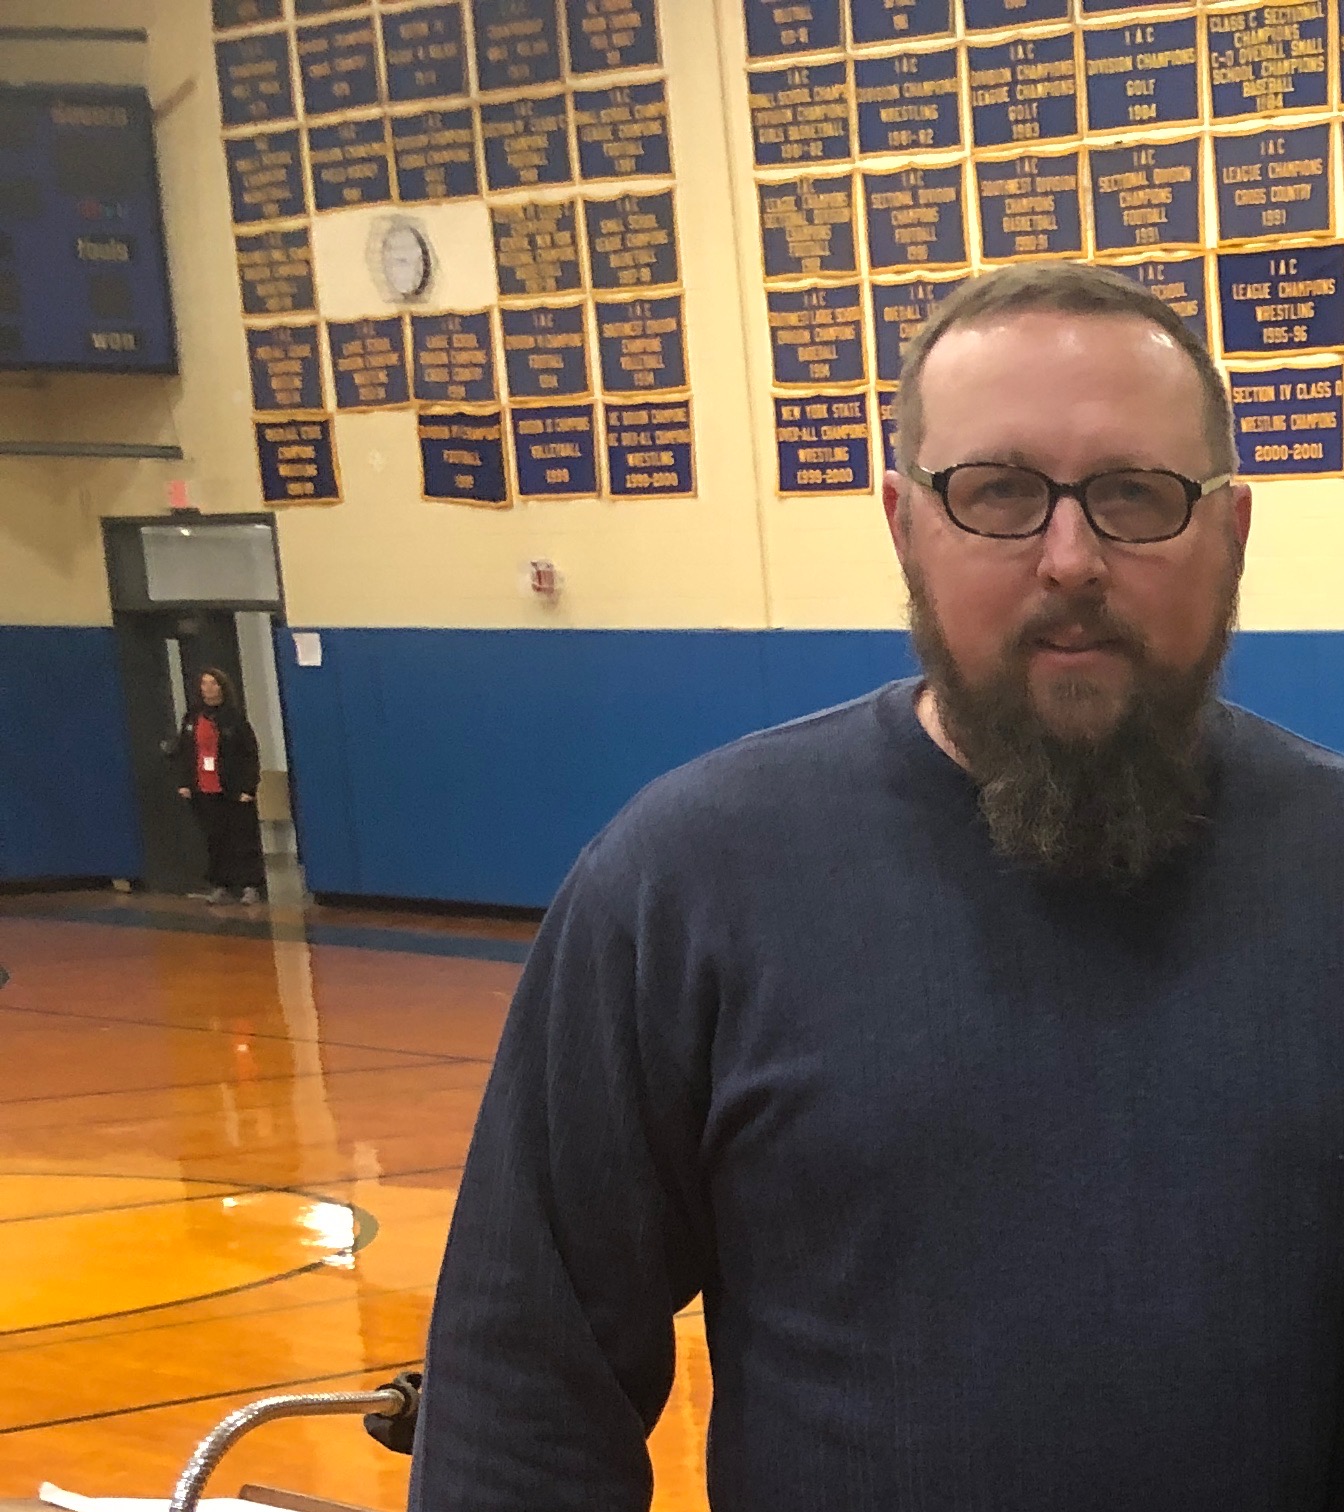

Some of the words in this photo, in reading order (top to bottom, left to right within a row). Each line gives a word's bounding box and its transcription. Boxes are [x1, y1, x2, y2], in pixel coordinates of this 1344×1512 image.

[1232, 283, 1271, 300] LEAGUE
[1279, 278, 1335, 298] CHAMPIONS
[1255, 302, 1314, 322] WRESTLING
[1233, 386, 1275, 403] SECTION
[1280, 385, 1292, 400] IV
[1297, 382, 1331, 399] CLASS
[1291, 412, 1336, 430] CHAMPIONS
[1255, 443, 1324, 462] 2000-2001
